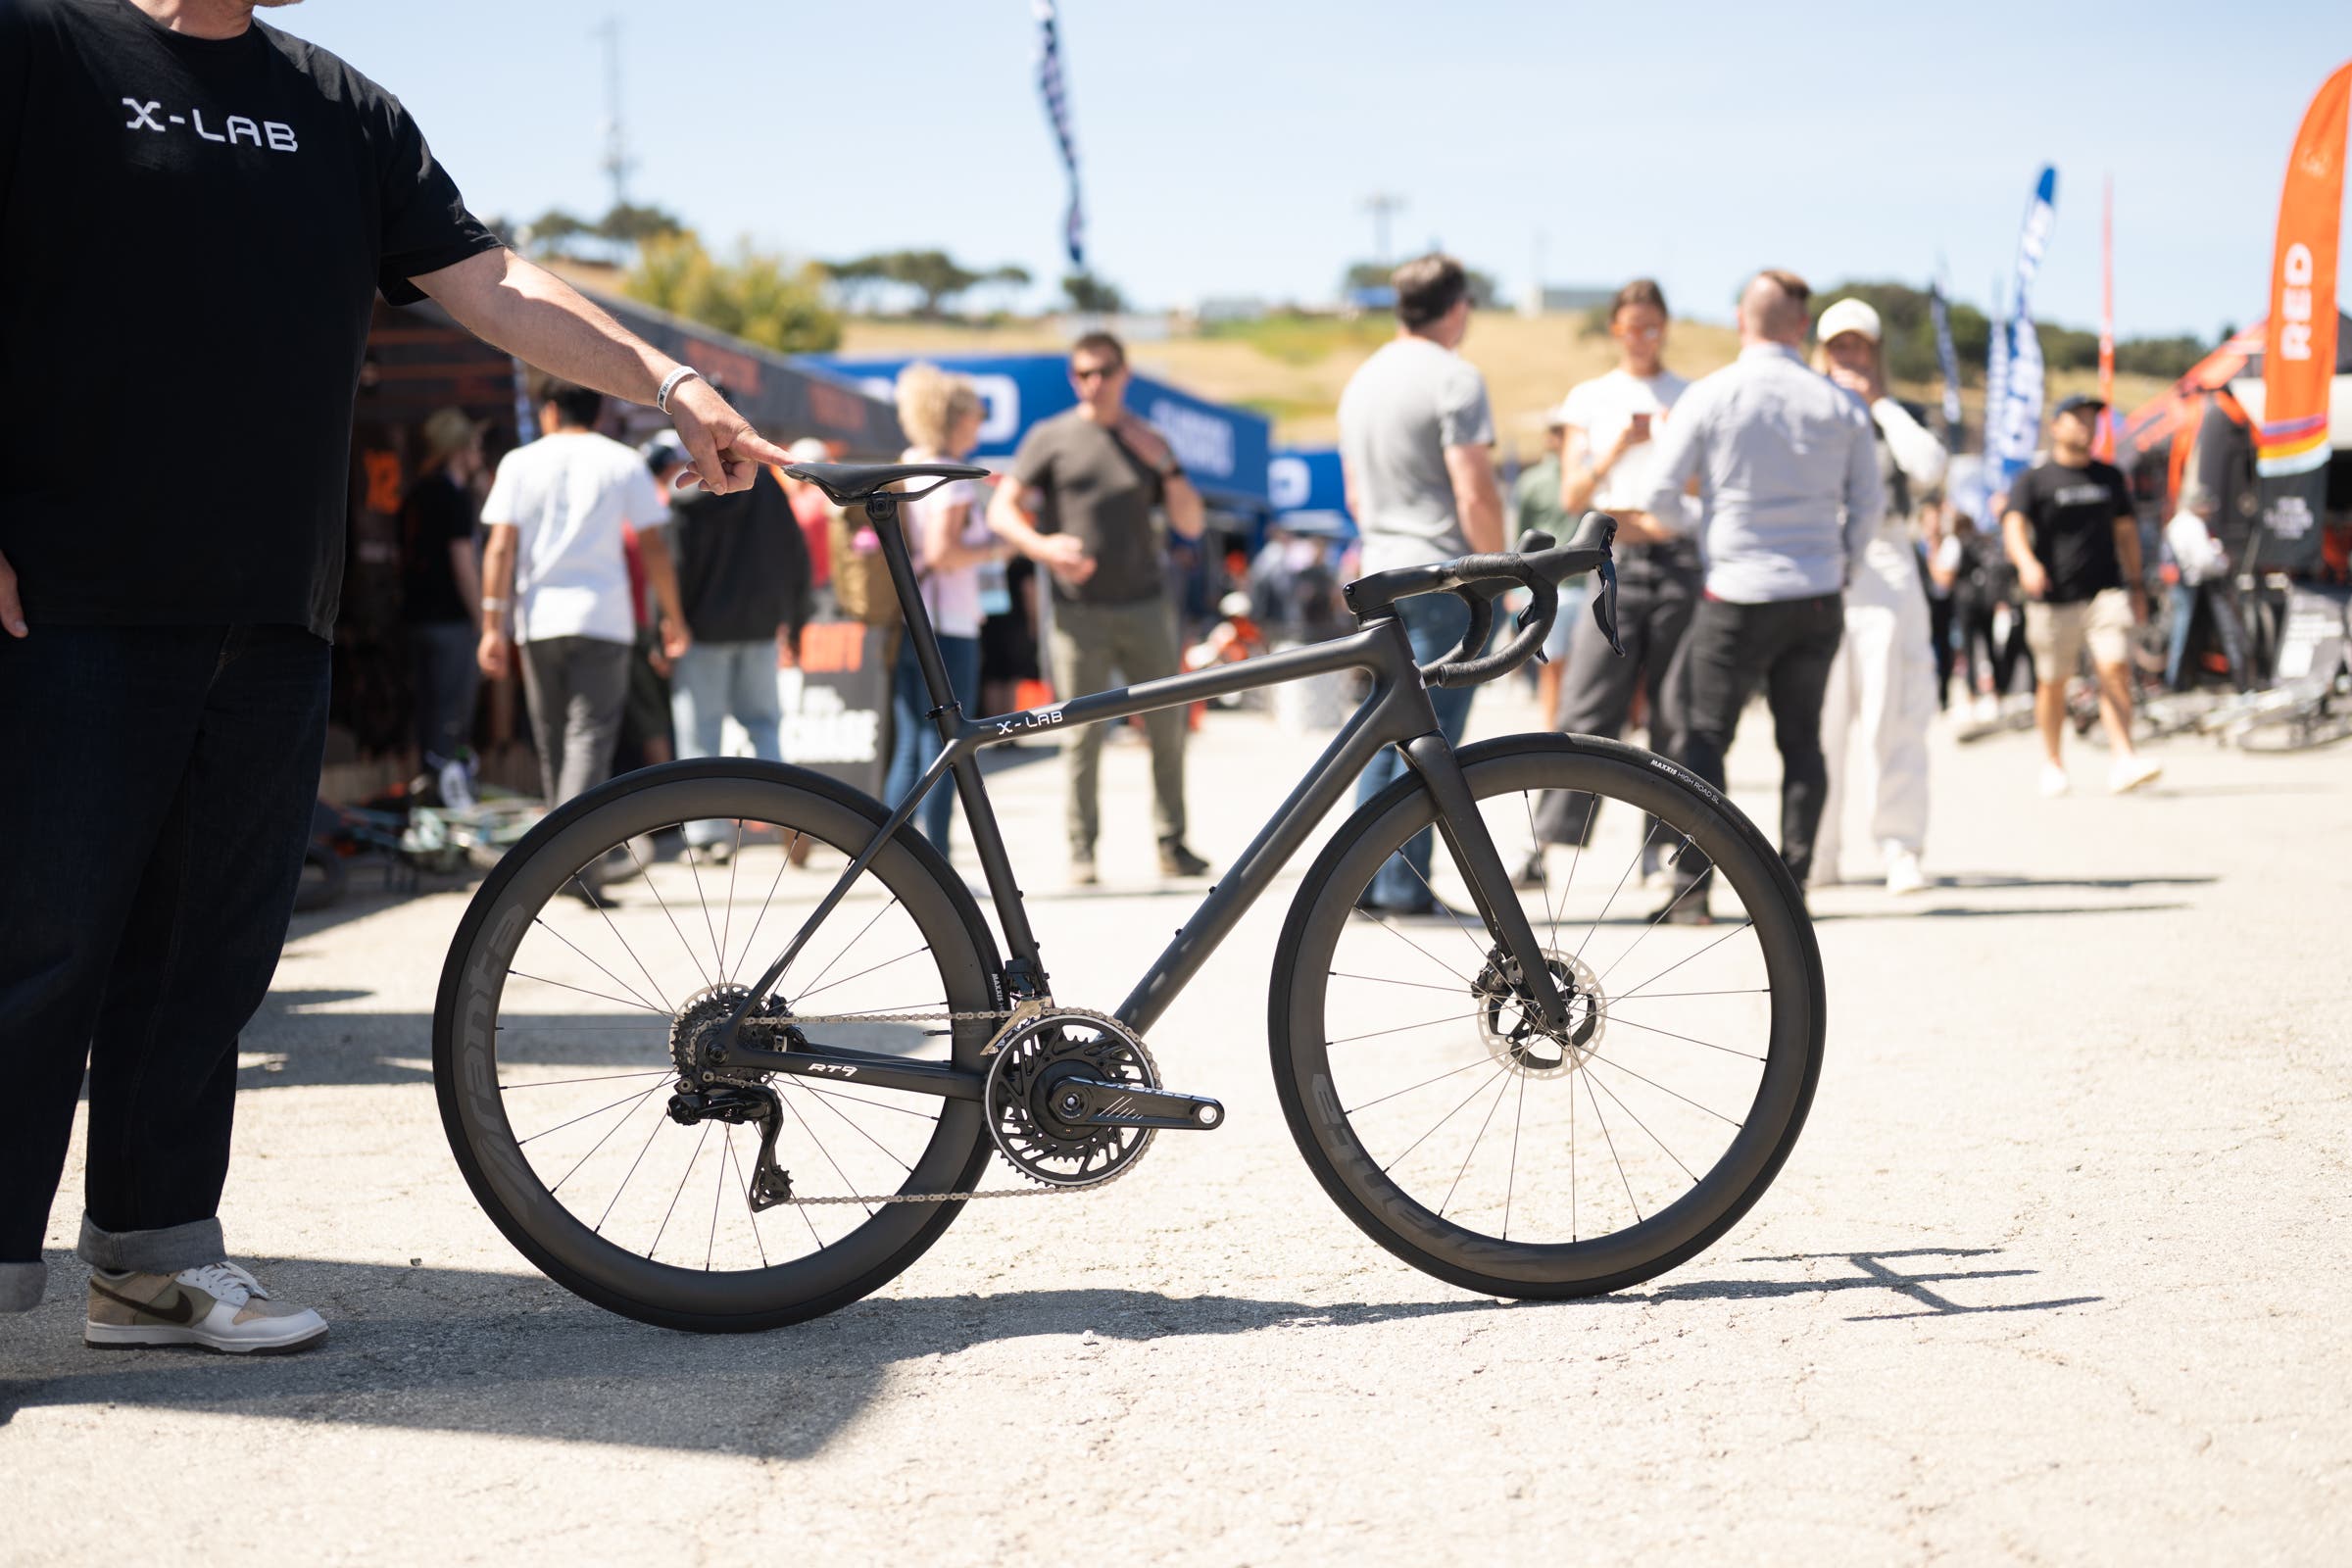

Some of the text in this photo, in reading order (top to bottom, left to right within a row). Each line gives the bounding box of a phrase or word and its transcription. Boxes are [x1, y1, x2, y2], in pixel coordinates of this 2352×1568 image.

[122, 98, 298, 152] X-LAB
[2280, 243, 2313, 361] RED
[997, 710, 1063, 735] X-LAB
[1650, 759, 1720, 805] MAXXIS HIGH ROAD SL
[992, 966, 1004, 1002] MAXXIS
[808, 1062, 858, 1077] RT9
